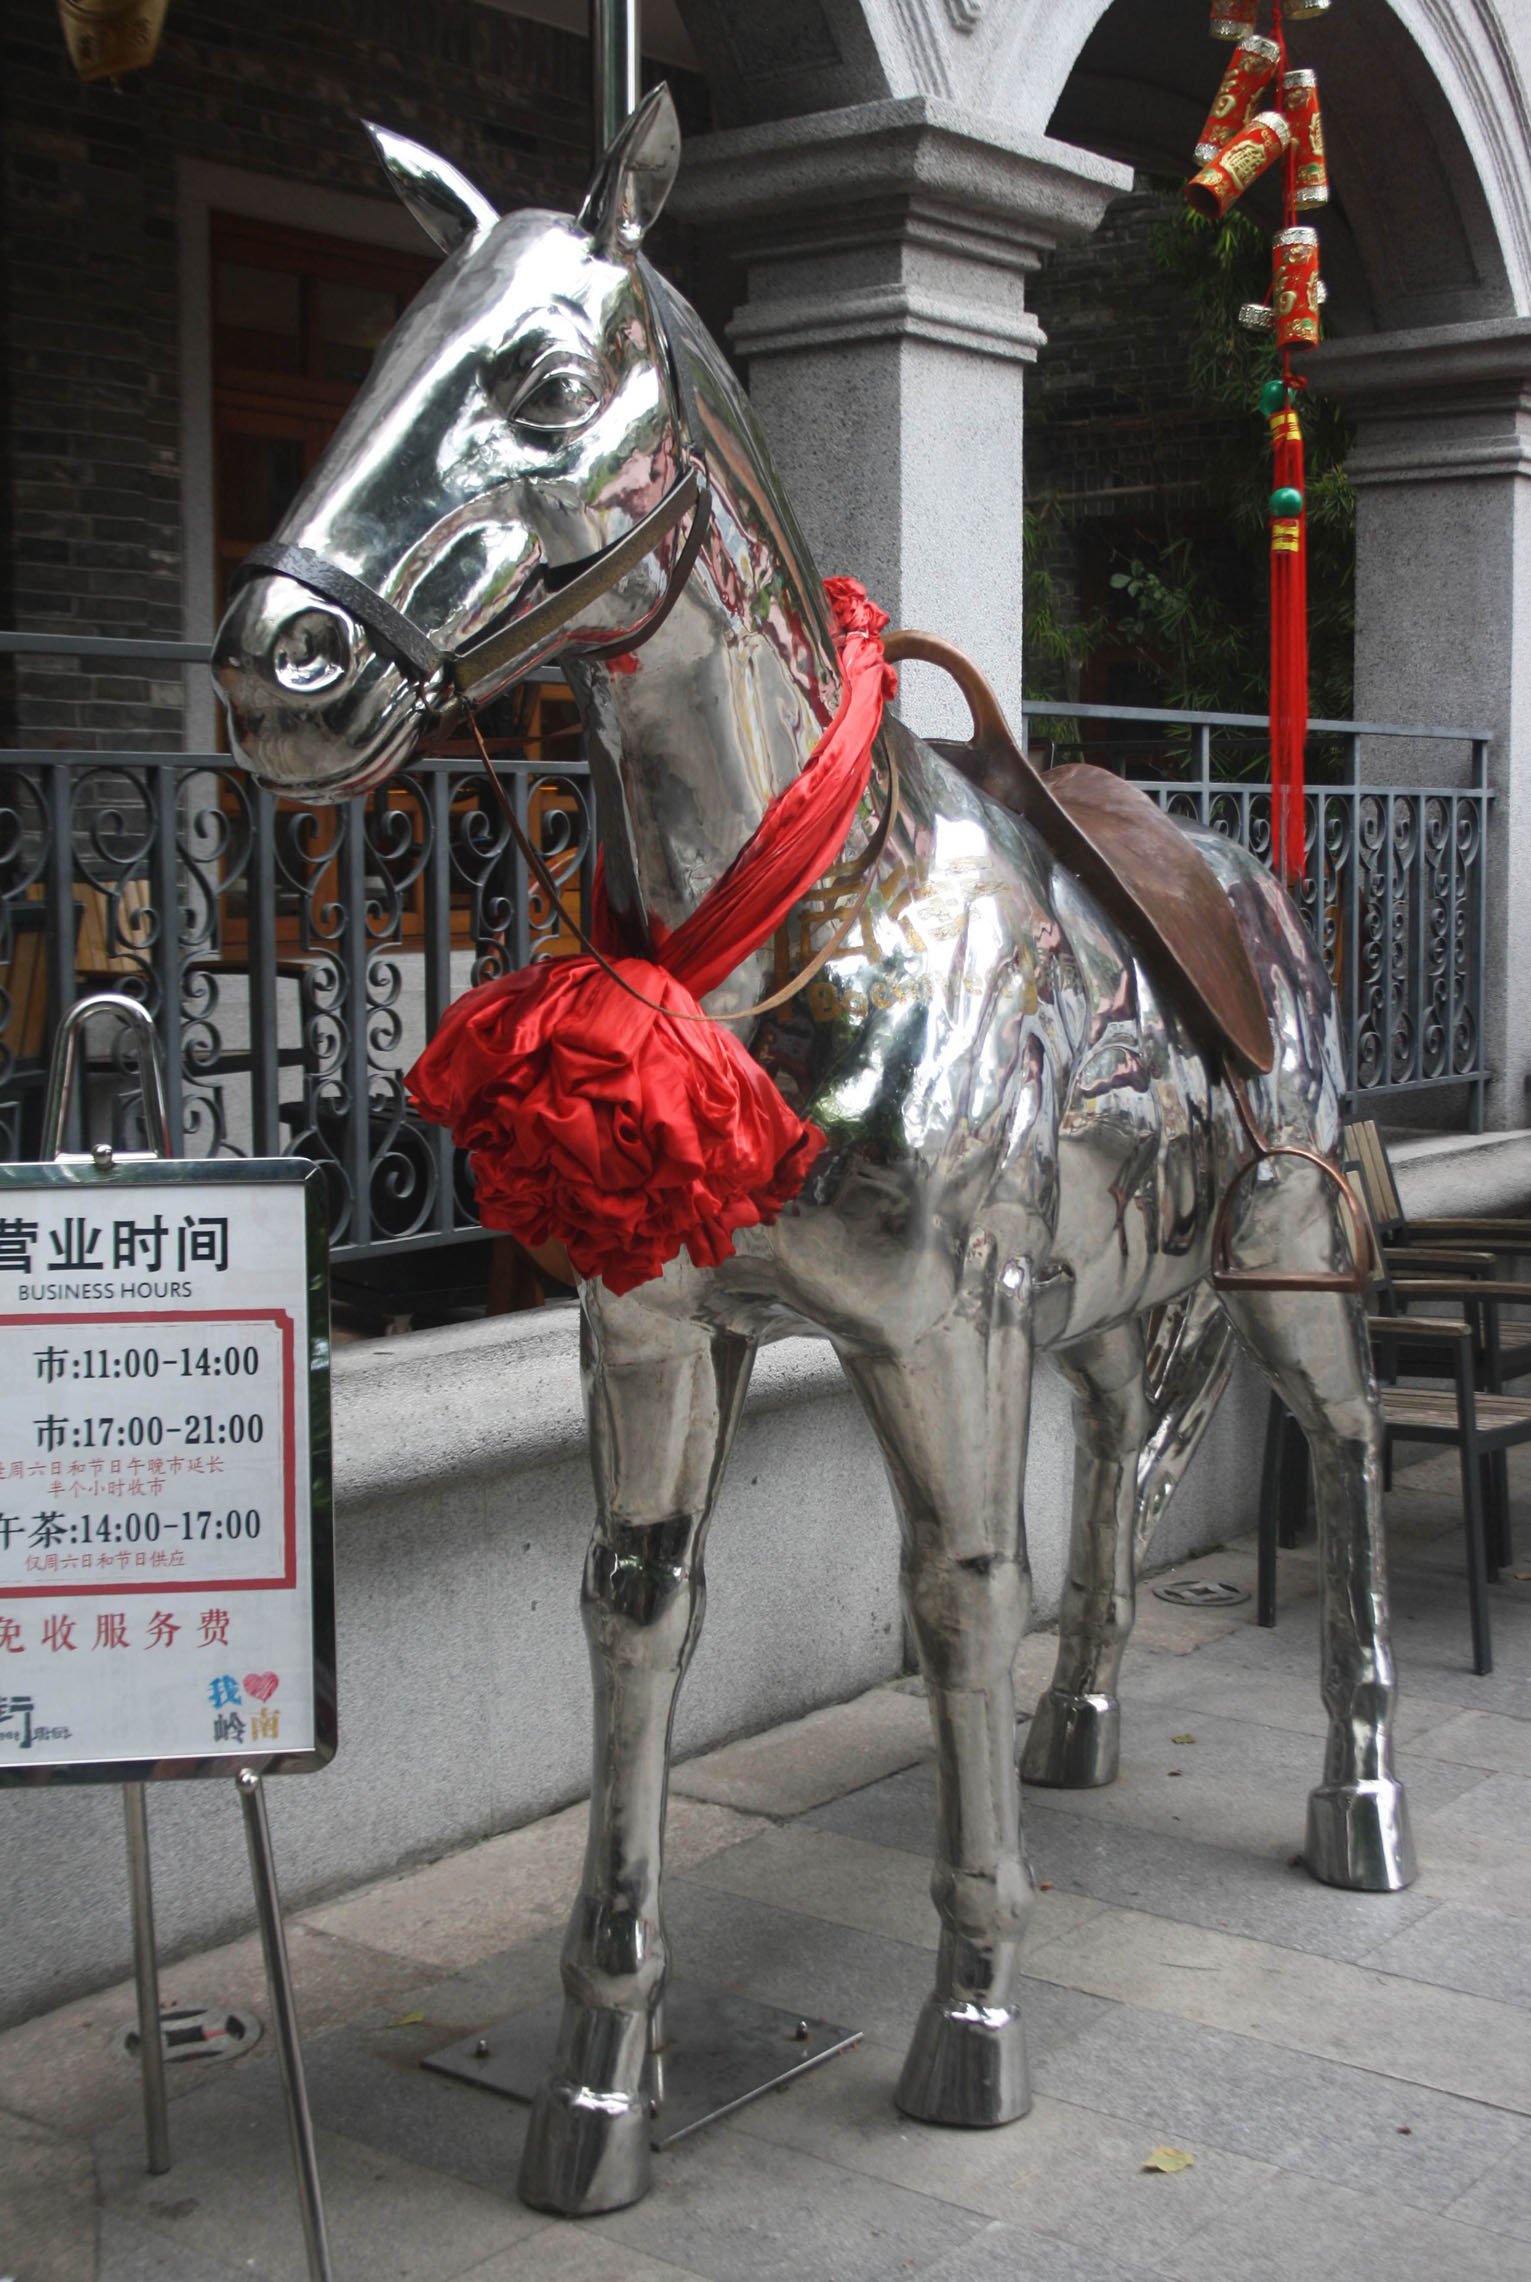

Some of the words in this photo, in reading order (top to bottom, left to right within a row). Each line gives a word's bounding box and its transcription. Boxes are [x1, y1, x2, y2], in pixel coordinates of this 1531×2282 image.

[0, 1214, 229, 1274] 营业时间
[18, 1283, 114, 1301] BUSINESS
[120, 1281, 193, 1299] HOURS
[0, 1455, 225, 1480] 周六日和节日午晚市延长
